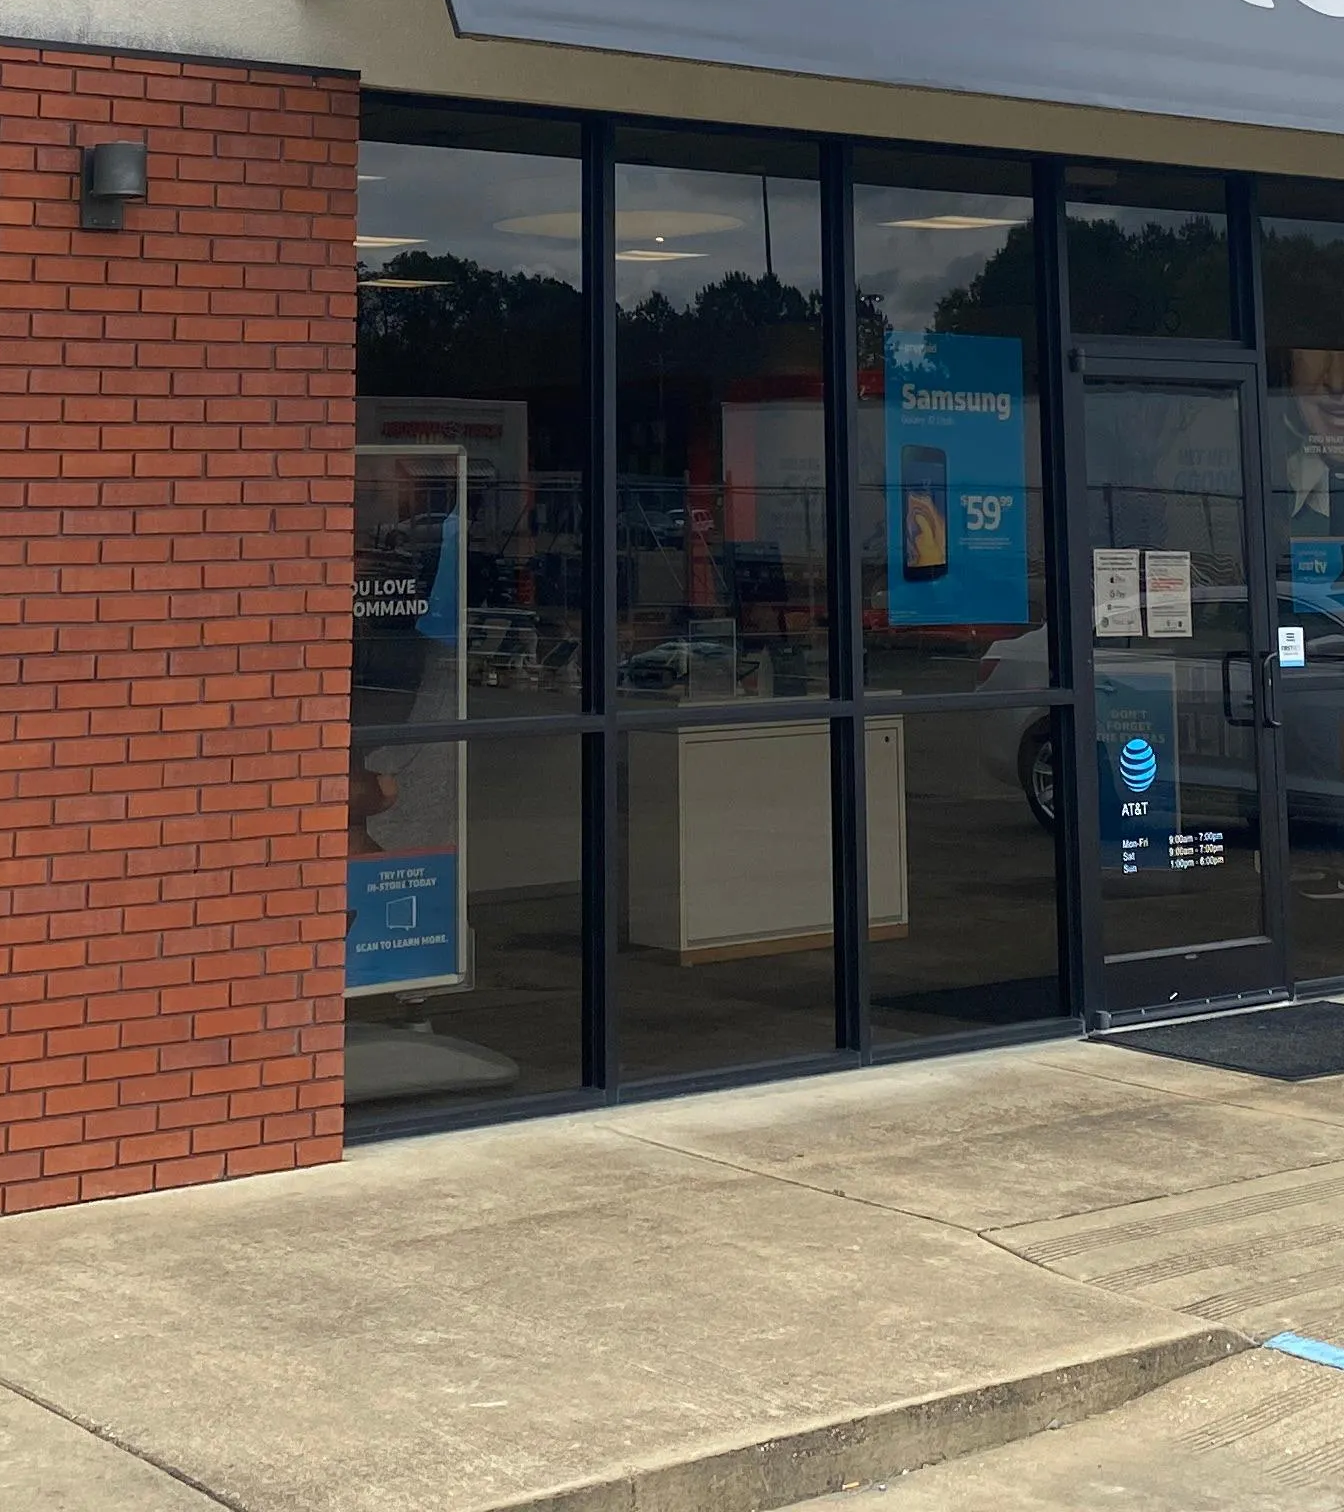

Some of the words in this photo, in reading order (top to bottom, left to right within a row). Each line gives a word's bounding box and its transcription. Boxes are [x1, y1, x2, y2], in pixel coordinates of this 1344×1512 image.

[901, 383, 1012, 421] Samsung
[374, 578, 416, 595] LOVE
[1121, 801, 1148, 817] AT&T
[1122, 837, 1149, 849] Mon-Fri
[1122, 851, 1136, 862] Sat
[379, 871, 396, 881] TRY
[396, 869, 405, 879] IT
[406, 868, 425, 877] OUT
[1123, 863, 1138, 874] Sun
[367, 880, 406, 892] IN-STORE
[408, 878, 437, 888] TODAY
[356, 941, 380, 953] SCAN
[380, 940, 392, 950] TO
[392, 936, 420, 948] LEARN
